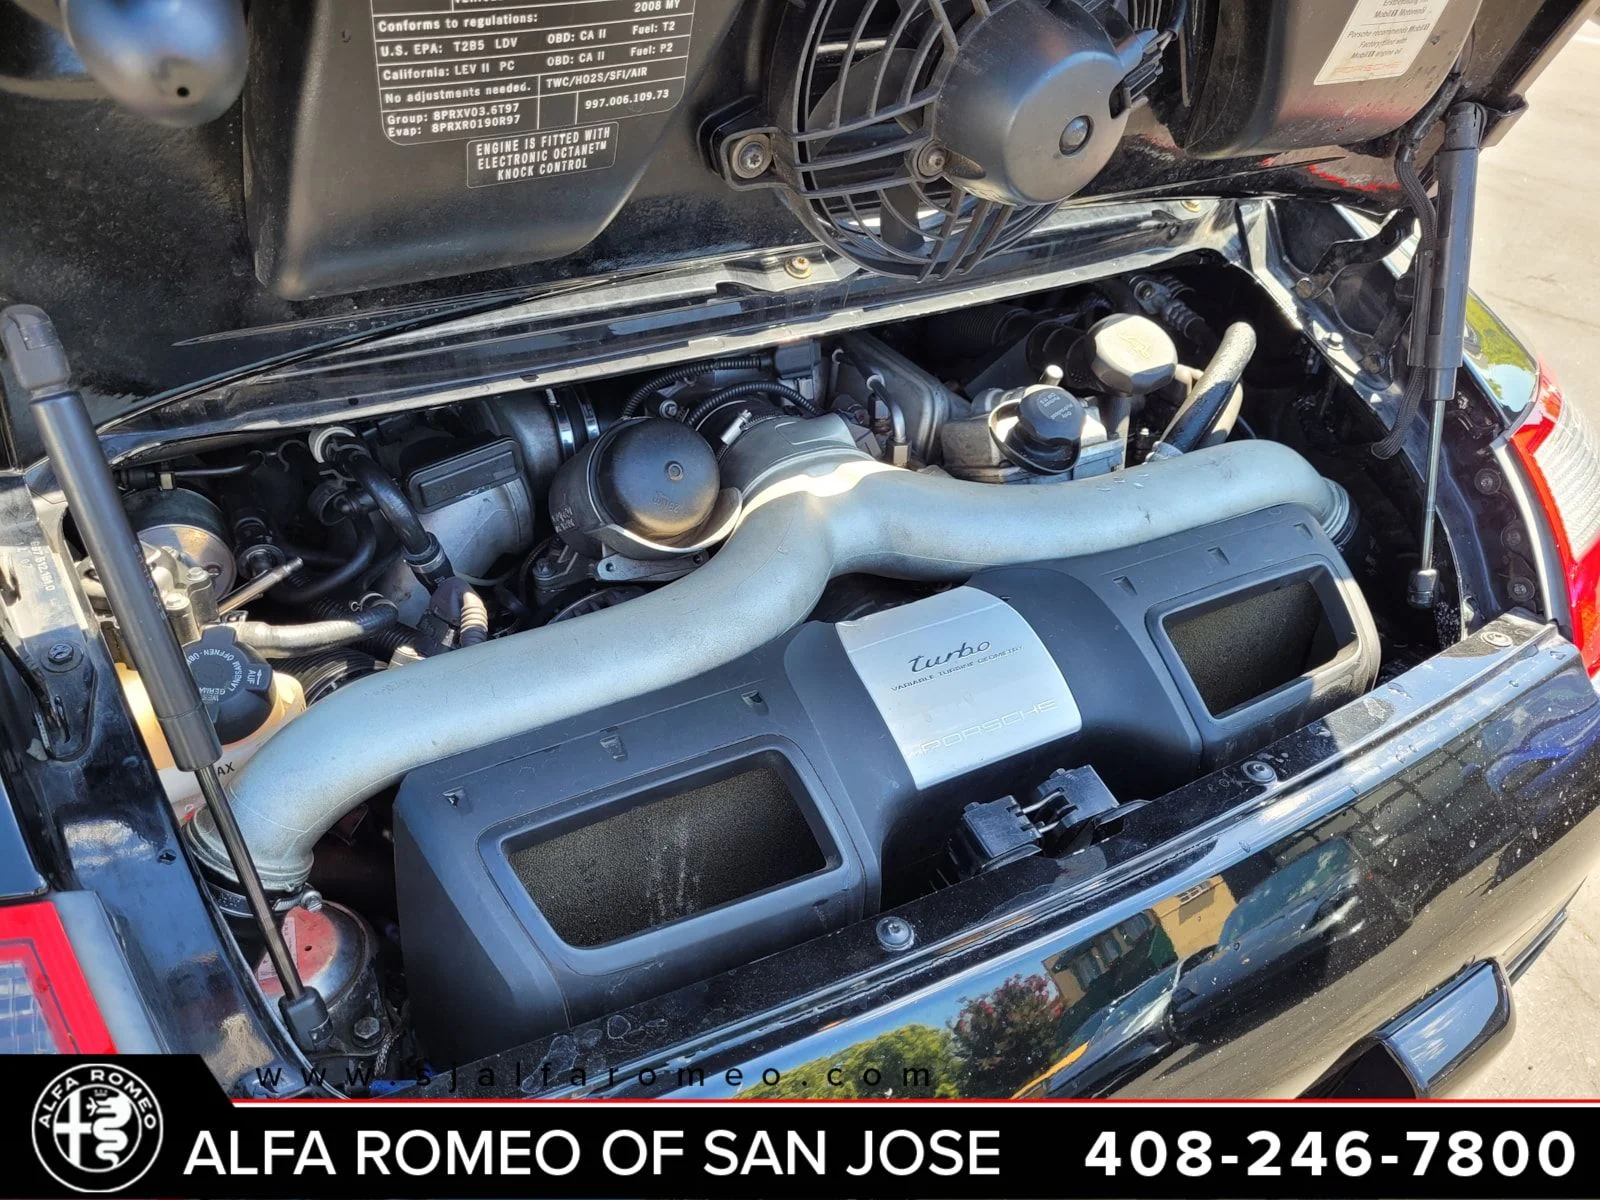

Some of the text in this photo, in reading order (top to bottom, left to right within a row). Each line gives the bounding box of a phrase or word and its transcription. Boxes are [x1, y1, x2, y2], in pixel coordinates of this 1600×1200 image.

[634, 0, 680, 13] 2008 MY
[378, 13, 538, 32] Conforms to regulations:
[380, 21, 676, 57] U.S. EPA: T2B5 LDV OBD: CA II Fuel: T2
[382, 42, 674, 81] California: LEV II PC OBD: CA II Fuel: P2
[384, 83, 531, 104] No adjustments needed.
[584, 89, 670, 110] 997.006.109.73
[387, 102, 520, 125] Group: 8PRXV03.6T97
[388, 125, 422, 138] Evap:
[476, 126, 611, 156] ENGINE IS FITTED WITH
[478, 149, 548, 170] ELECTRONIC
[497, 157, 588, 181] KNOCK CONTROL
[908, 641, 990, 672] turbo
[247, 669, 257, 685] AUF
[890, 674, 934, 692] VARIABLE
[939, 661, 974, 676] TURBINE
[920, 698, 1058, 756] PORSCHE
[217, 761, 235, 776] AX
